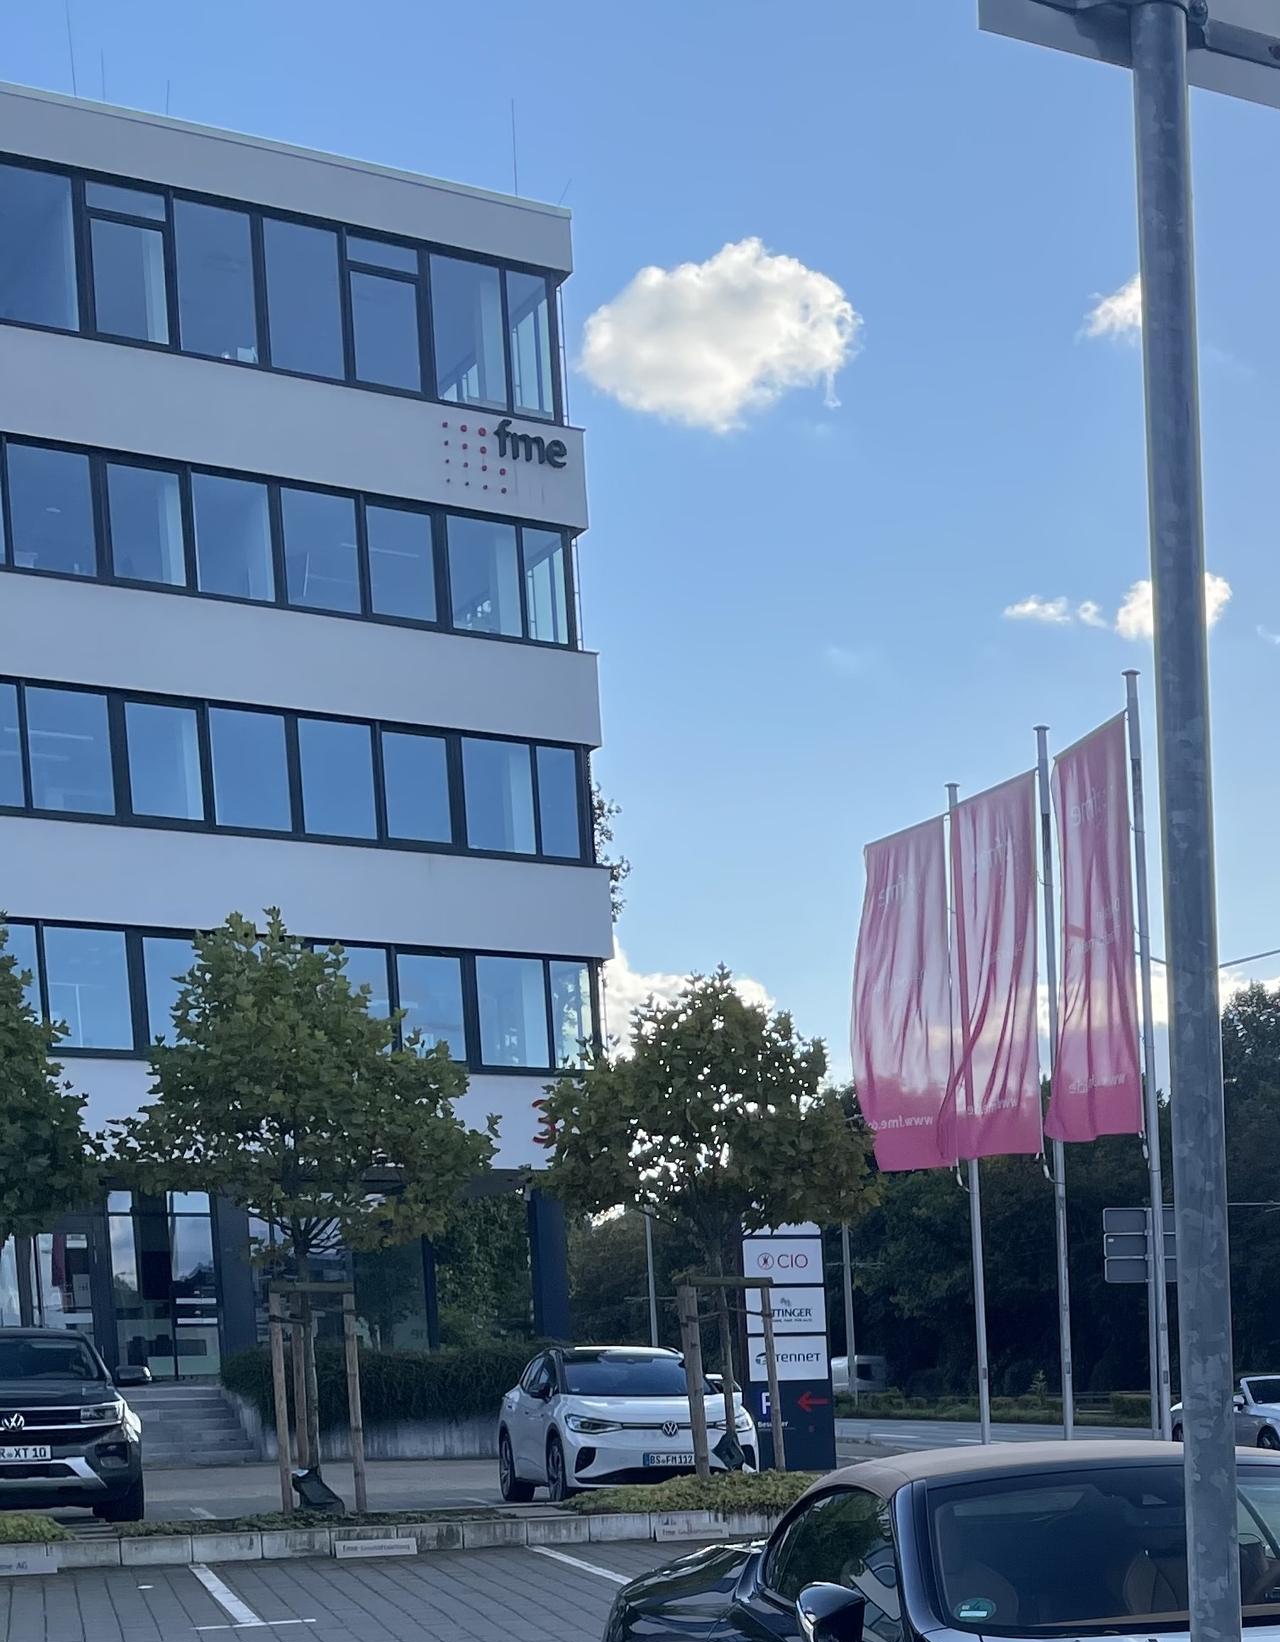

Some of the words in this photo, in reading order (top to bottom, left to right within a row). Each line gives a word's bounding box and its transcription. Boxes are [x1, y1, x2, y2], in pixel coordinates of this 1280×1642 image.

[493, 419, 567, 469] fme
[777, 1253, 809, 1269] CIO
[772, 1307, 813, 1318] TTINGER
[14, 1447, 30, 1459] XT
[32, 1447, 47, 1459] 10
[650, 1455, 661, 1465] BS
